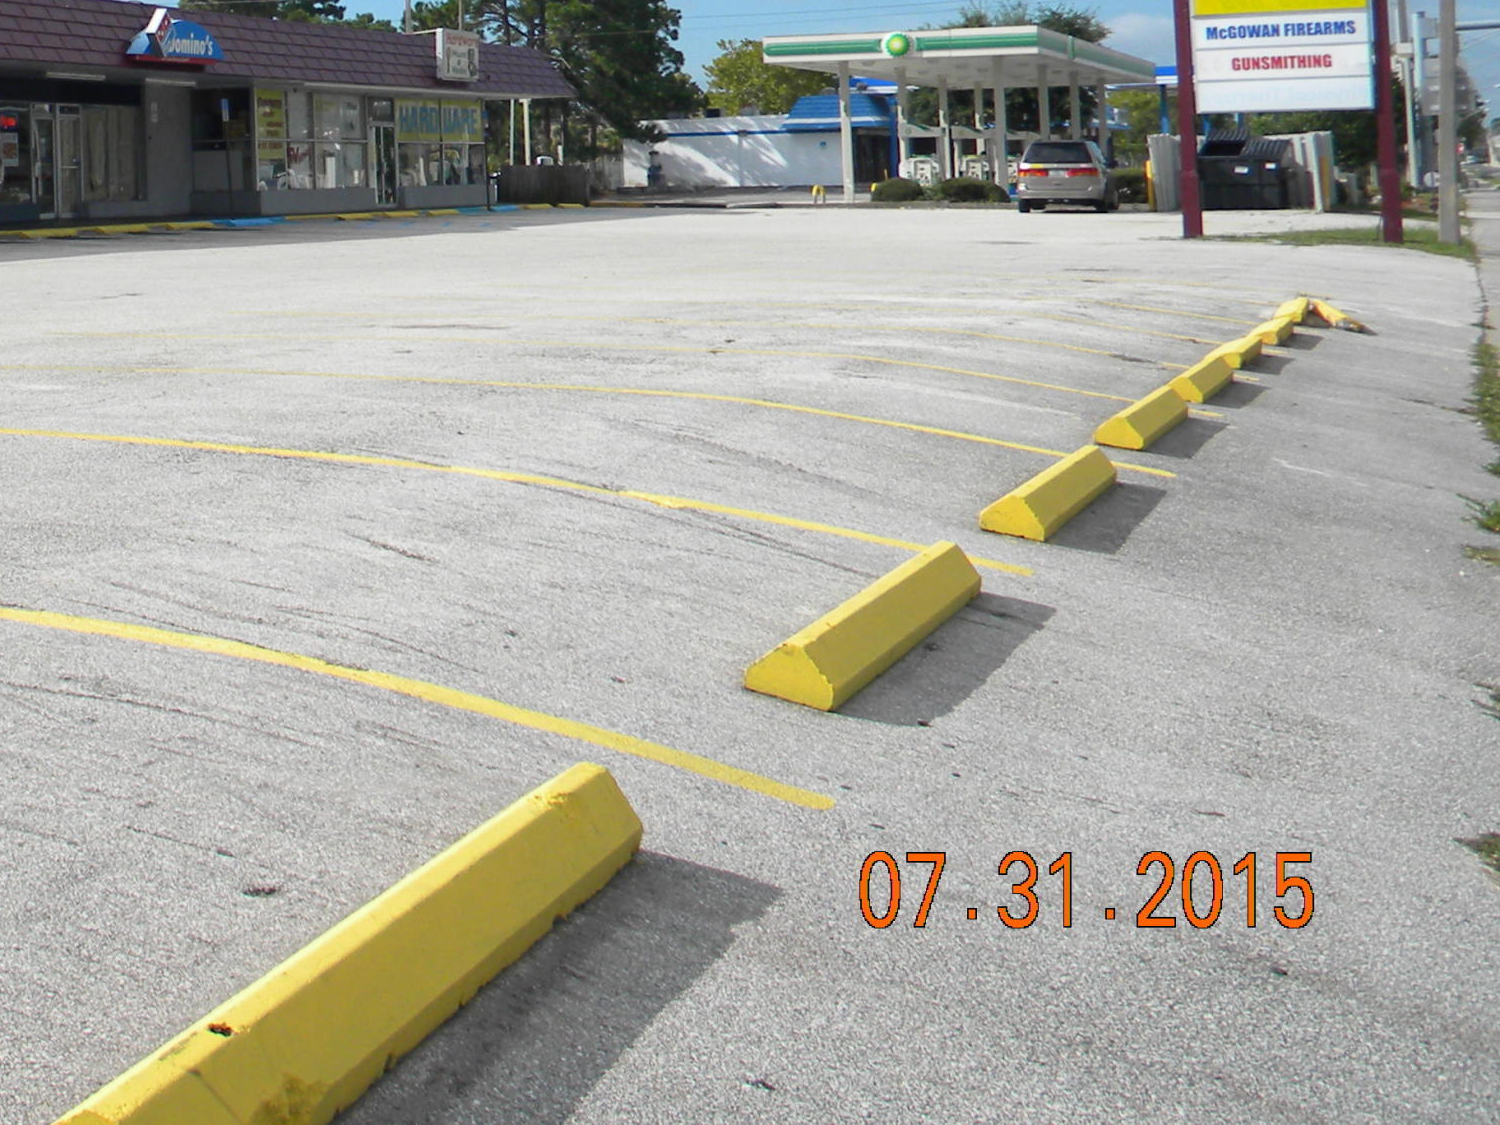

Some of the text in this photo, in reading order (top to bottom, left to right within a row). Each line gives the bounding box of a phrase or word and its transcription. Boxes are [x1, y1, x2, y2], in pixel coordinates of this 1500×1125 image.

[1206, 20, 1356, 41] McGOWAN FIREARMS
[1231, 54, 1333, 72] GUNSMITHING
[399, 106, 478, 135] HARDWARE
